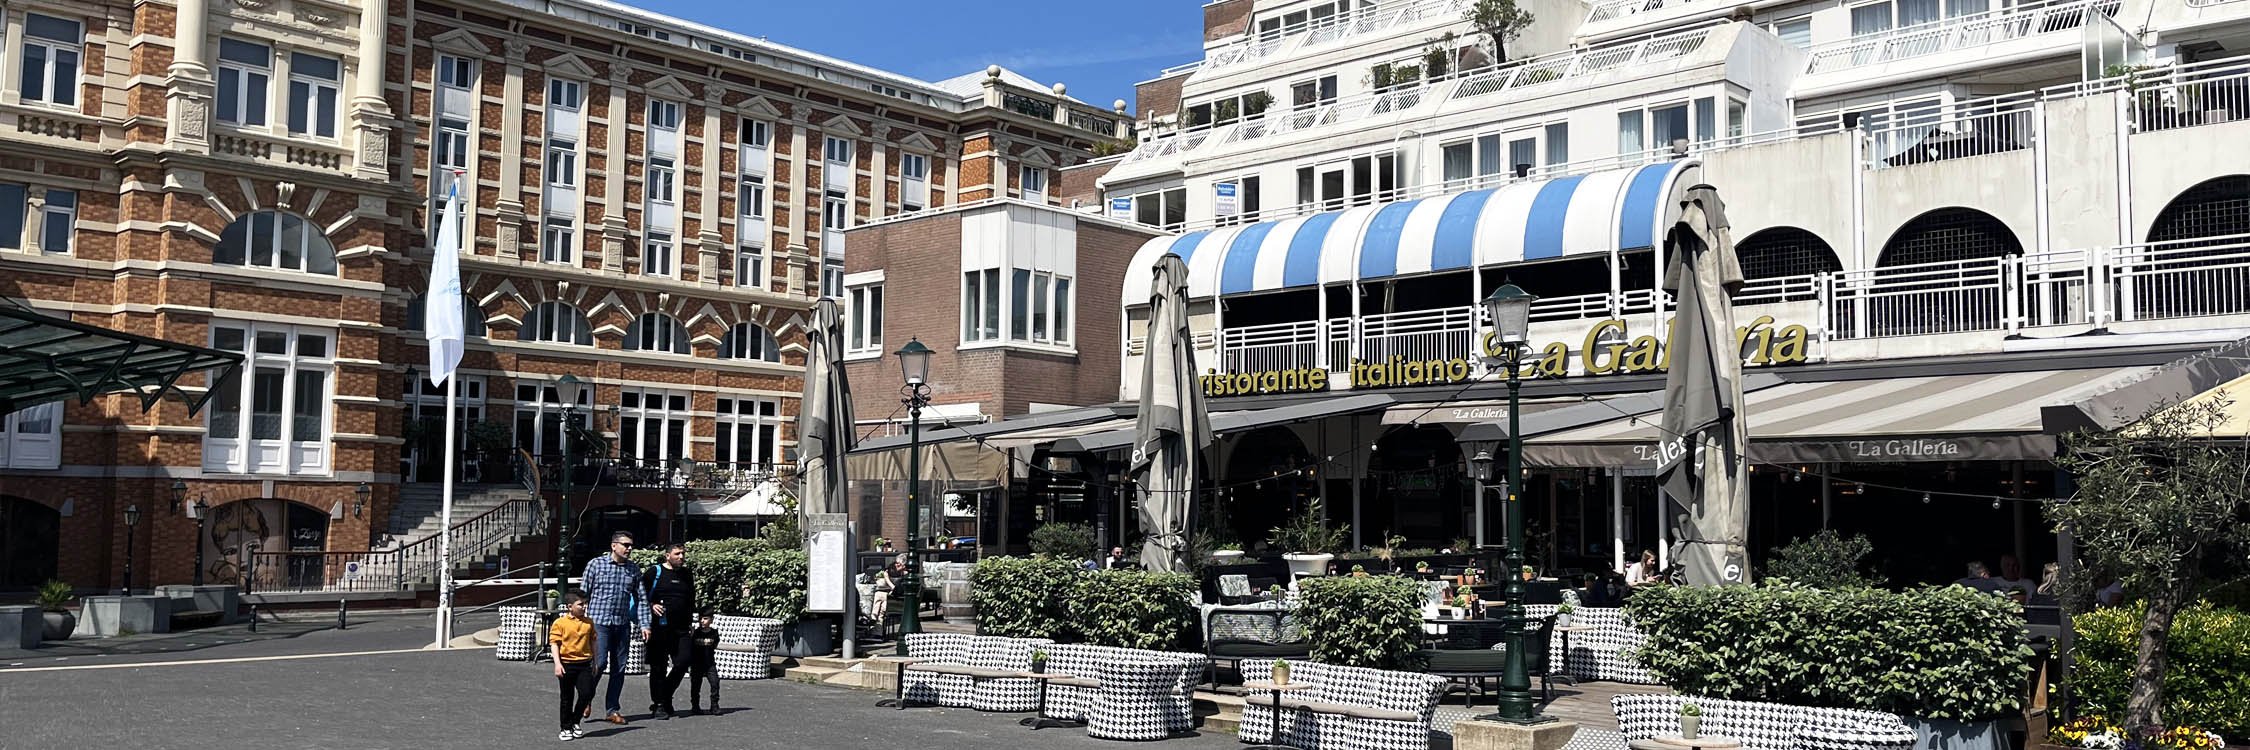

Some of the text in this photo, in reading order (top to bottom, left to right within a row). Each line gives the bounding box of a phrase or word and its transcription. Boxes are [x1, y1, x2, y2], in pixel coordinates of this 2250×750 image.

[1199, 366, 1327, 396] ristorante
[1350, 354, 1467, 388] italiano
[1582, 315, 1808, 373] Galria
[1453, 407, 1508, 419] La Galleria
[1849, 439, 1958, 456] La Galleria
